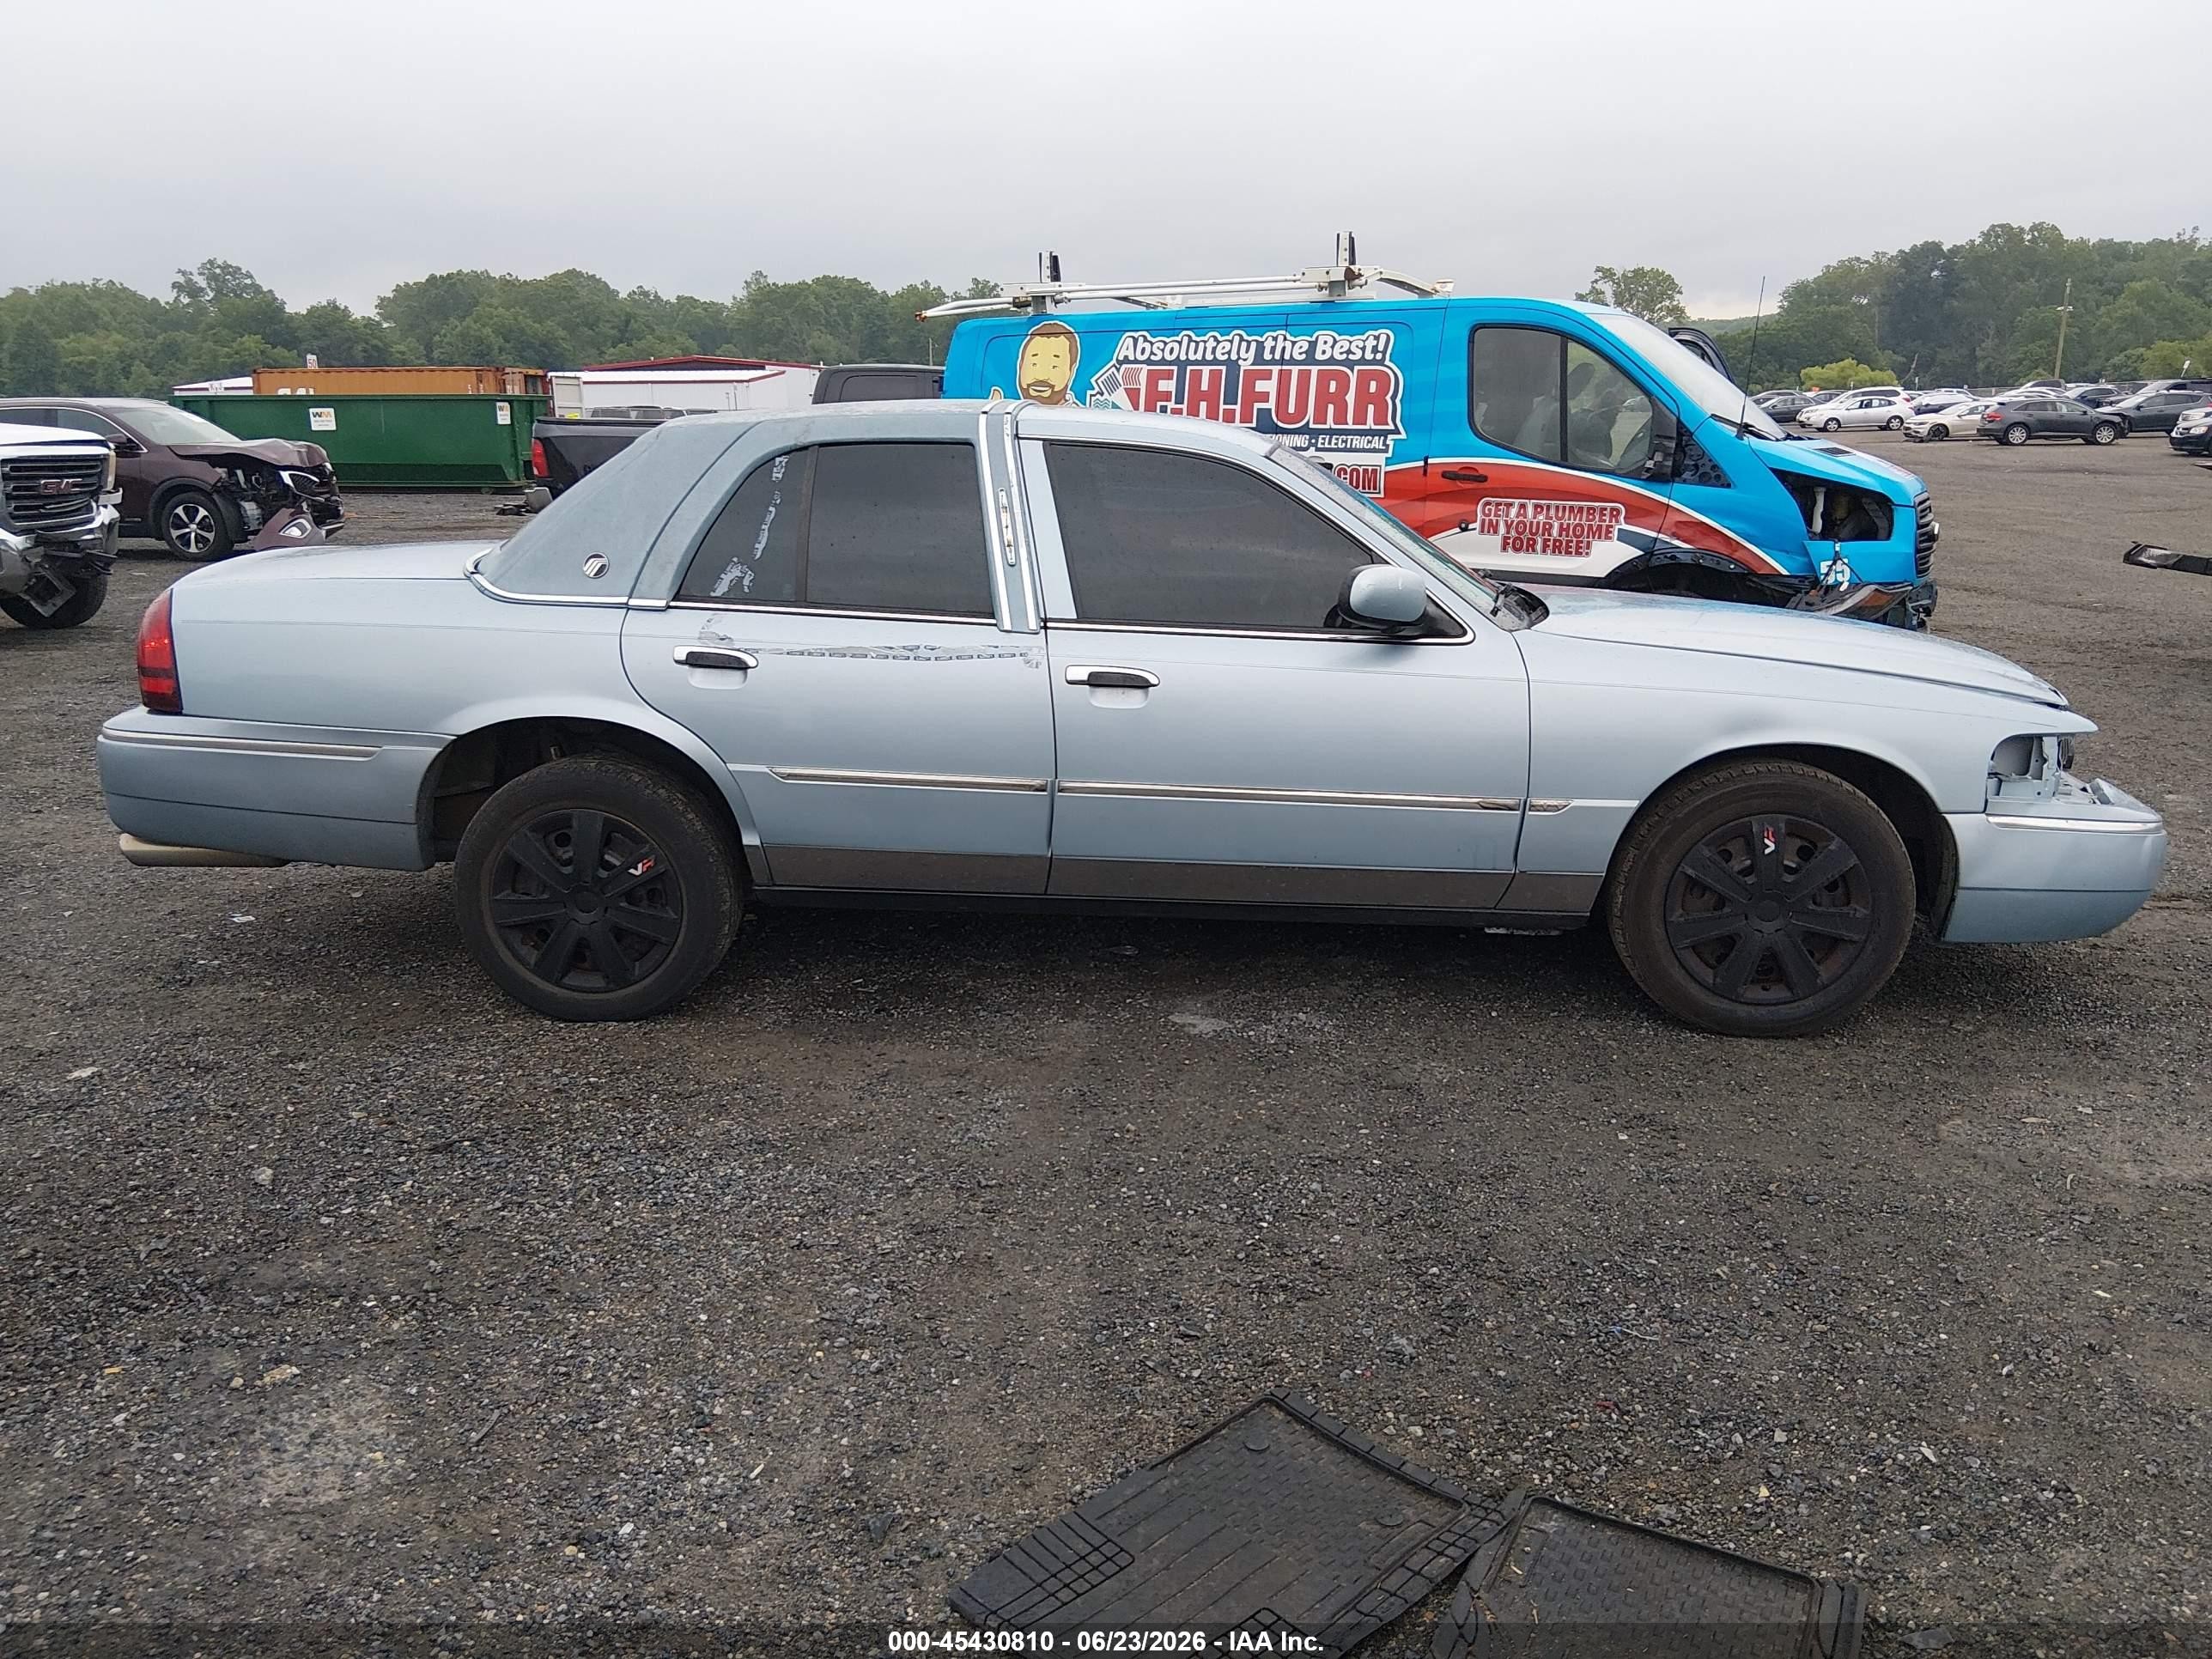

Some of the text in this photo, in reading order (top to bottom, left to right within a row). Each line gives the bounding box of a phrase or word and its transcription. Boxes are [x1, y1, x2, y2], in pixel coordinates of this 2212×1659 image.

[1118, 333, 1388, 366] Absolutely the Best!
[1317, 434, 1386, 449] ELECTRICAL
[40, 477, 83, 495] GMC
[1480, 501, 1621, 524] GET A PLUMBER
[1480, 519, 1613, 540] IN YOUR HOME
[1501, 535, 1592, 556] FOR FREE!
